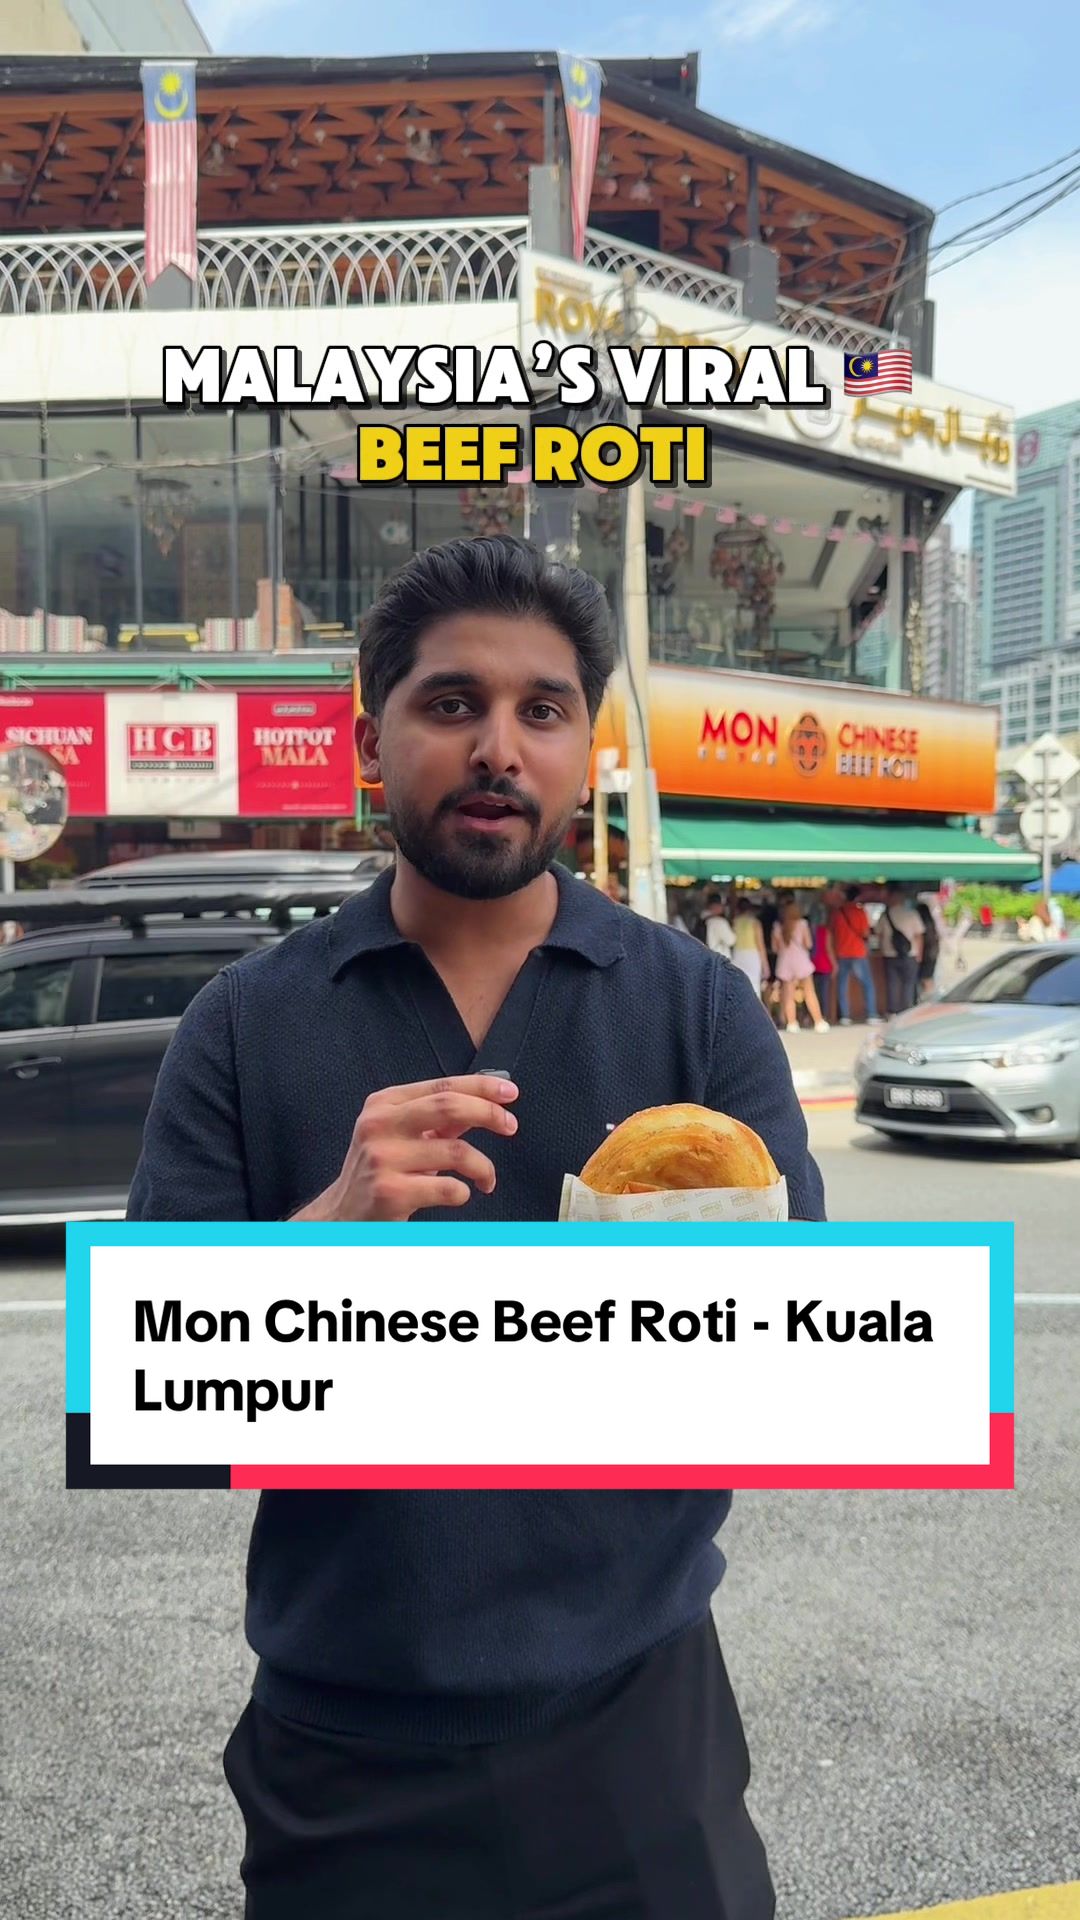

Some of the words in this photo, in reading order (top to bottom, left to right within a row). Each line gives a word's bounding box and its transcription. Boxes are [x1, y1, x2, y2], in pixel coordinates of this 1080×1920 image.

[5, 726, 93, 745] SICHUAN
[133, 726, 213, 752] HCB
[253, 727, 336, 746] HOTPOT
[701, 710, 778, 747] MON
[838, 722, 918, 754] CHINESE
[261, 746, 329, 767] MALA
[836, 752, 873, 777] BEEF
[877, 756, 918, 781] ROTI
